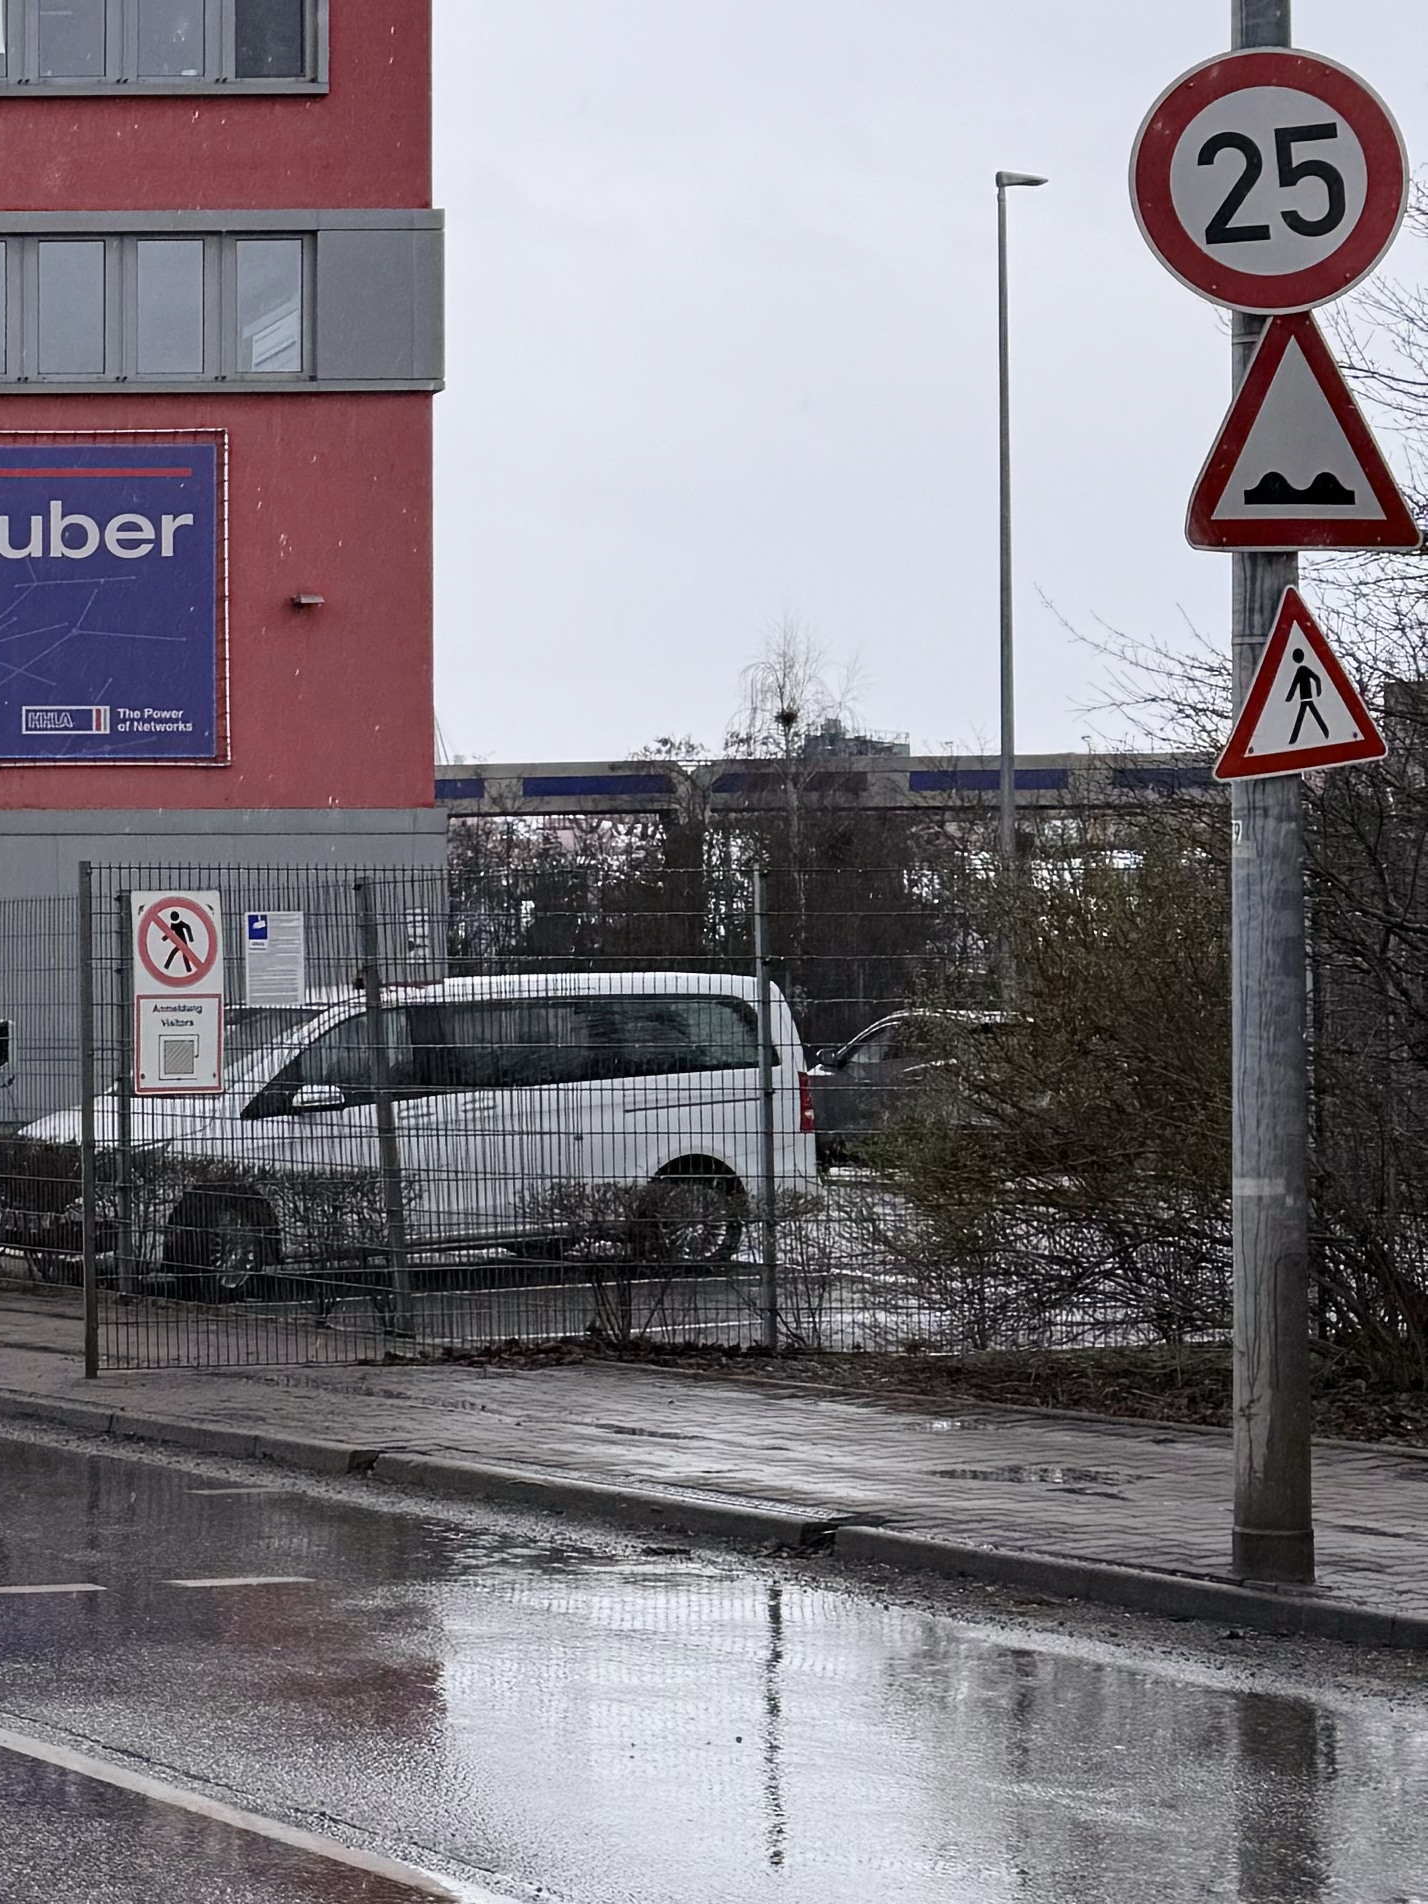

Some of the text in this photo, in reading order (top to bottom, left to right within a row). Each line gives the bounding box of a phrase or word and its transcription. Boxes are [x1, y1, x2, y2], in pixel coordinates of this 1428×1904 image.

[1196, 122, 1346, 245] 25
[116, 708, 184, 719] The Power
[27, 711, 74, 729] HHLA
[117, 720, 193, 732] of Networks
[152, 1003, 203, 1014] Anmeldung
[160, 1018, 194, 1027] Visitors
